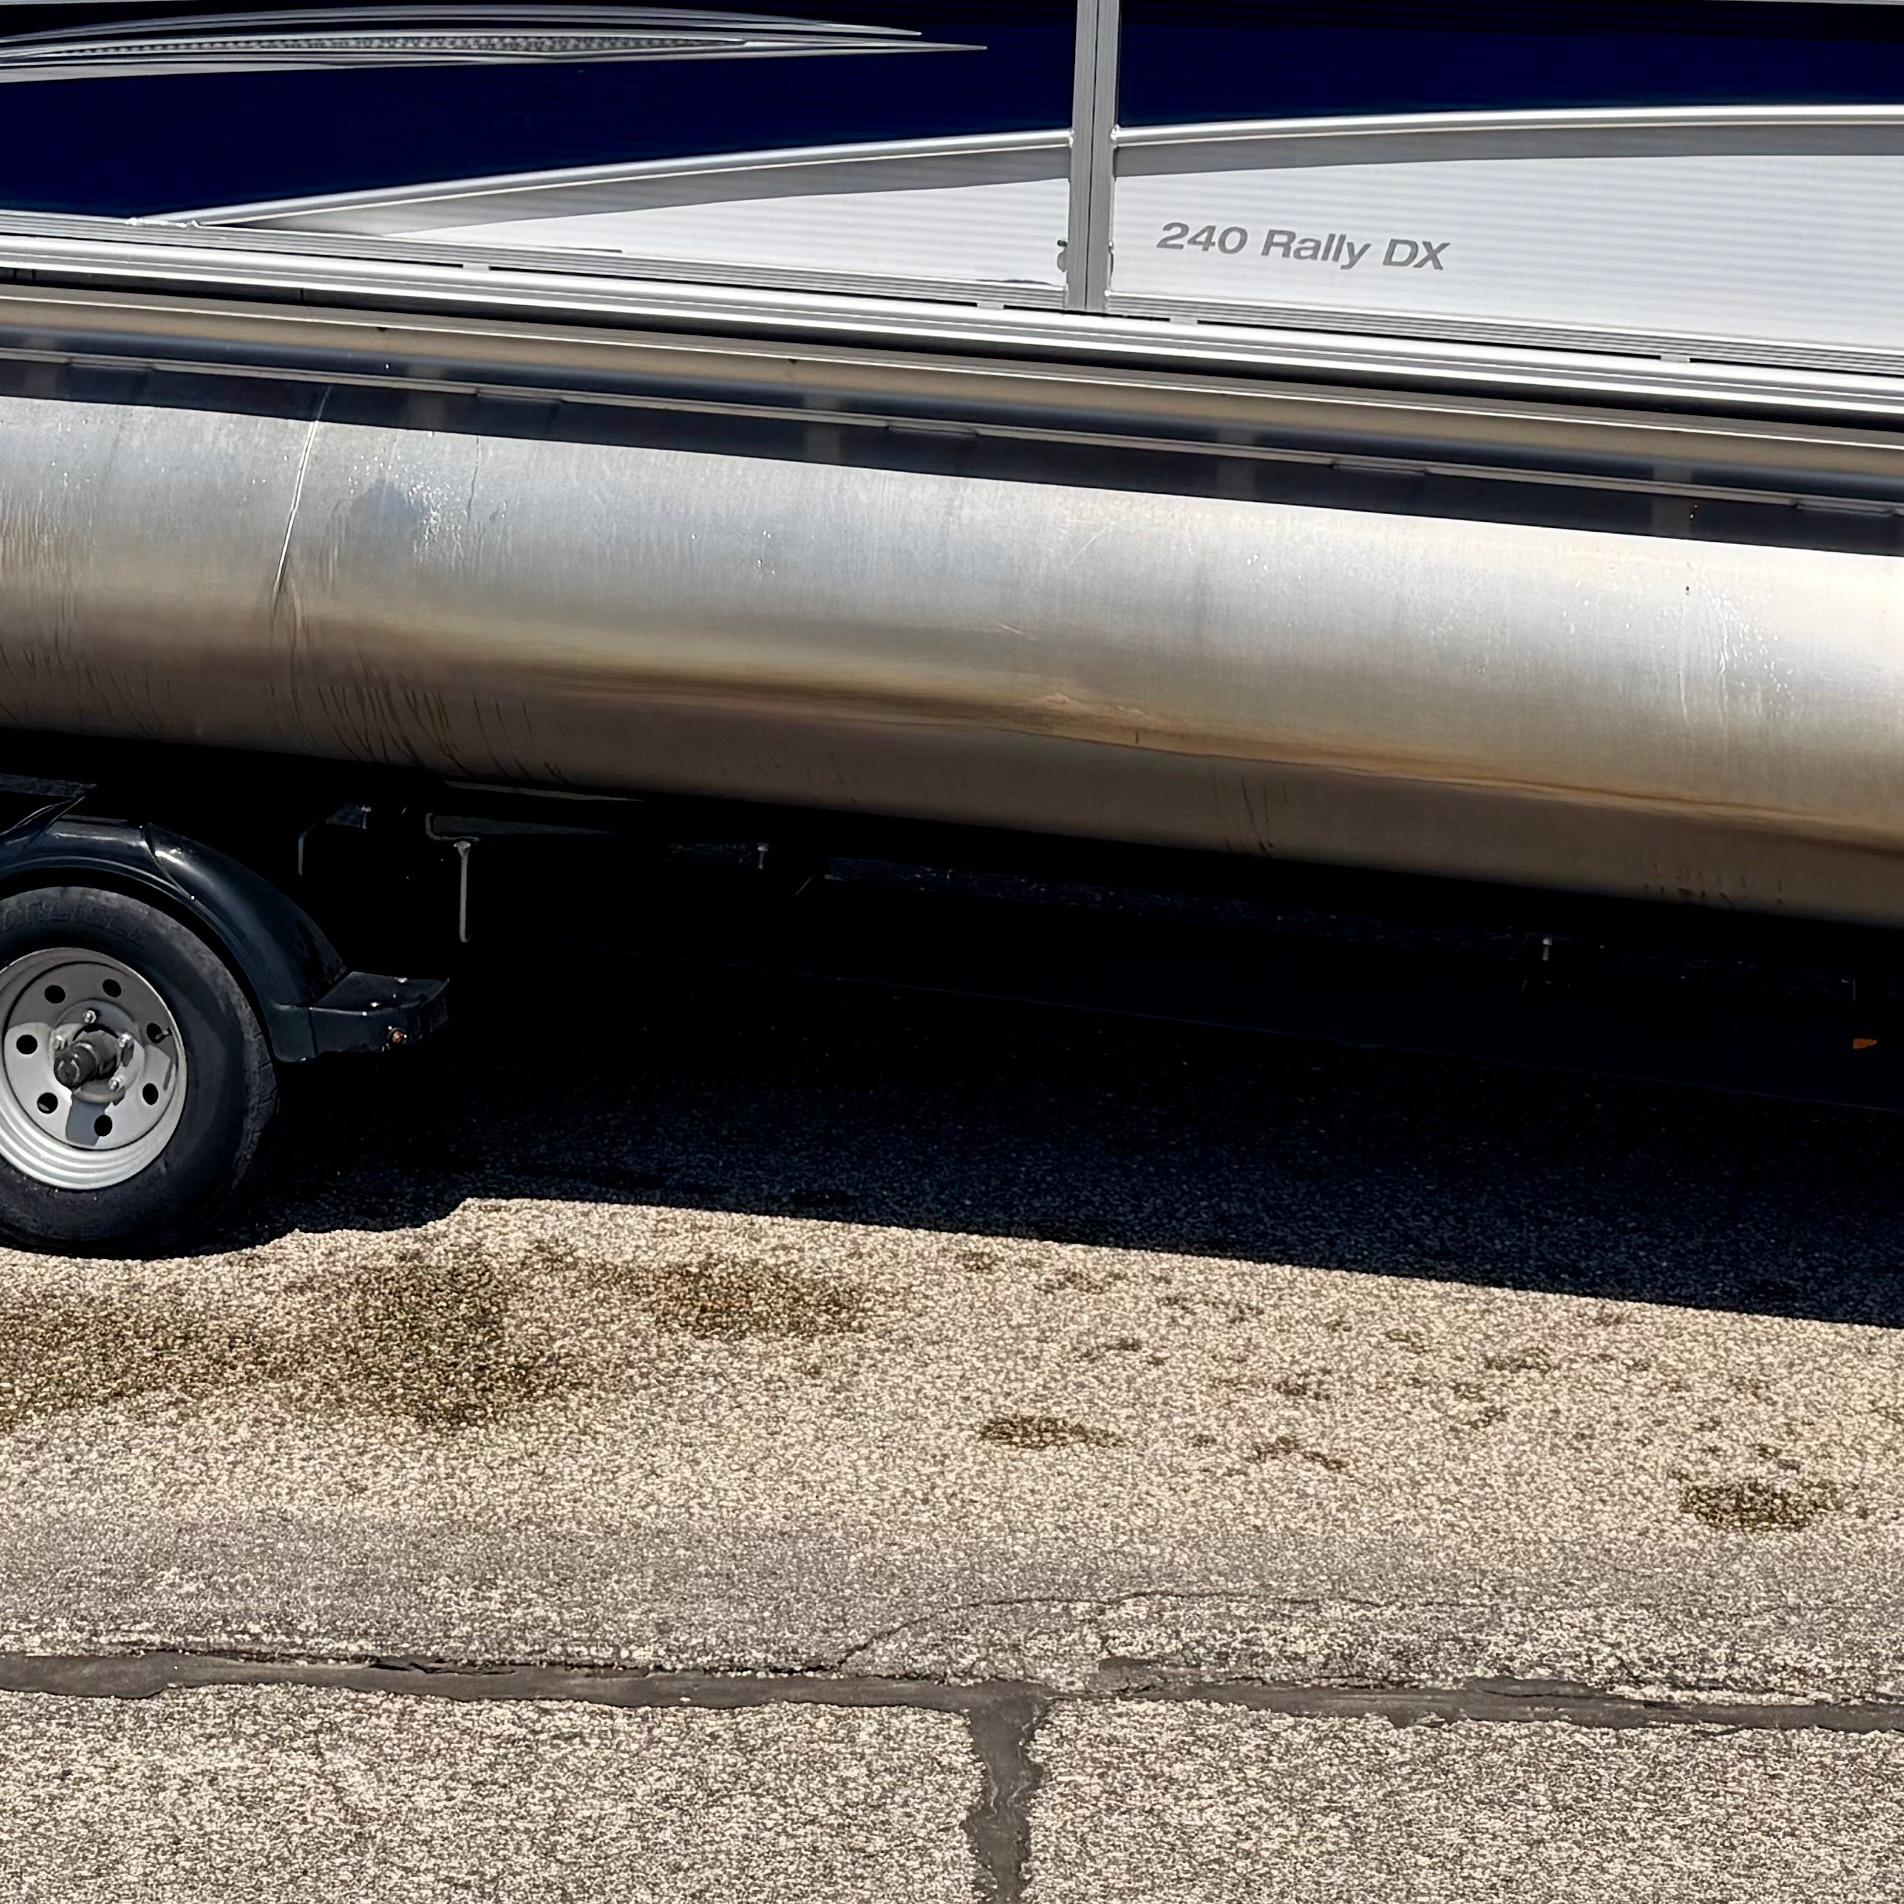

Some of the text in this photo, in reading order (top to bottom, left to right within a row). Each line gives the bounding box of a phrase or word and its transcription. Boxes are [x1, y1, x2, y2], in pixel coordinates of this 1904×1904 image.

[1156, 221, 1450, 271] 240 Rally DX
